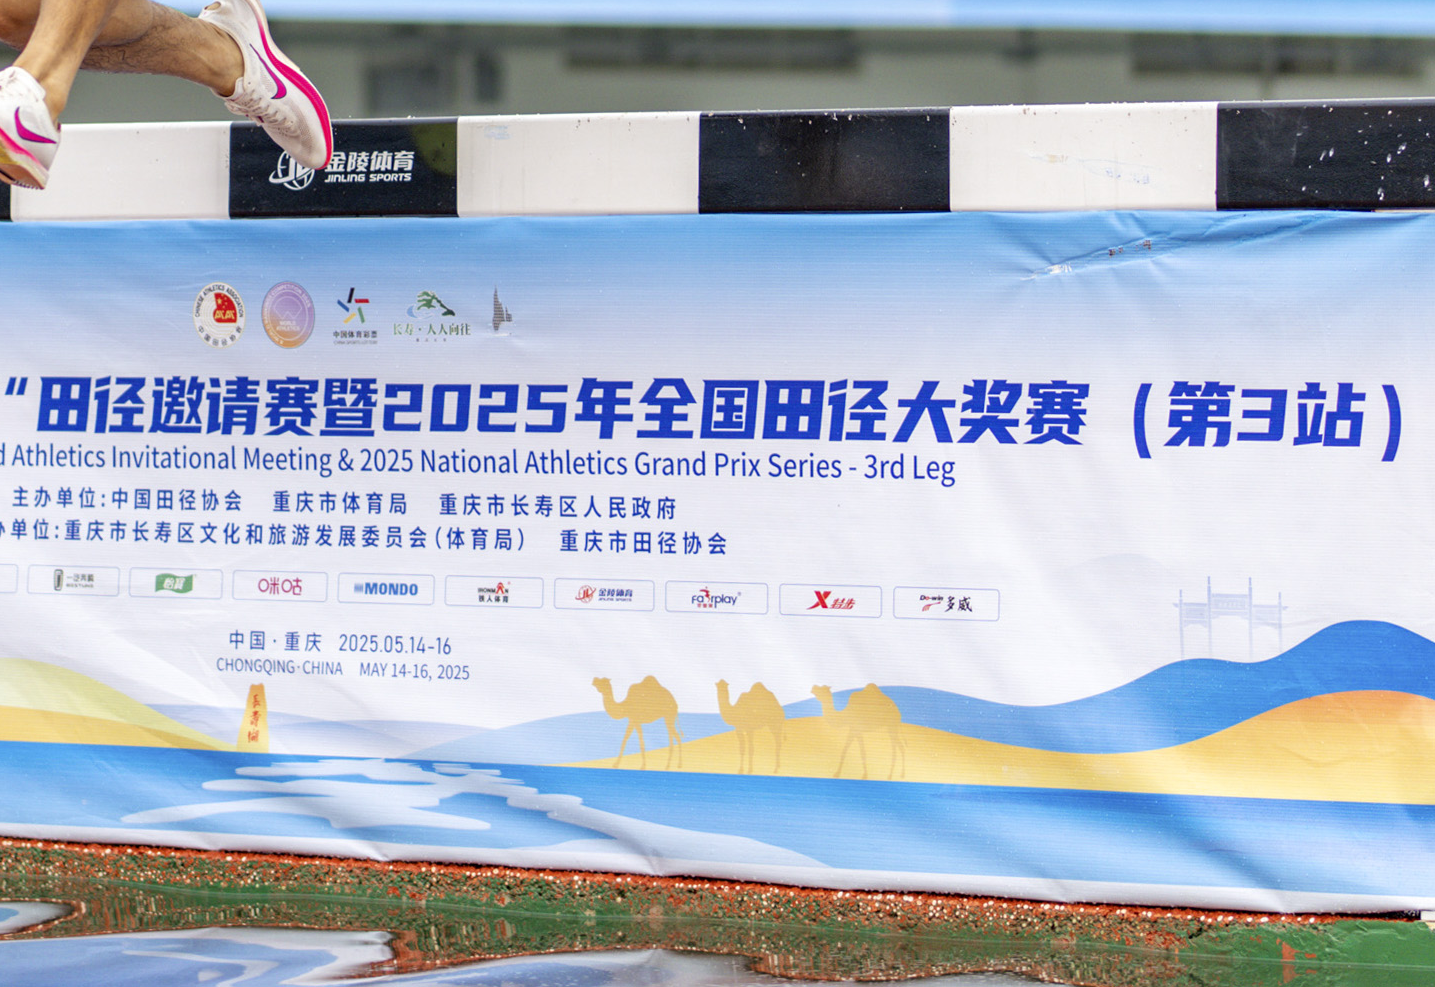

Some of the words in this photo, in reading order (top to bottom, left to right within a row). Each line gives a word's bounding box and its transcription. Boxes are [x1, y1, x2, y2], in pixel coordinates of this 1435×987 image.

[324, 150, 415, 173] 金陵体育
[324, 173, 366, 183] JINLING
[369, 172, 412, 182] SPORTS
[12, 443, 106, 468] Athletics
[112, 444, 236, 469] Invitational
[243, 446, 333, 478] Meeting
[337, 448, 354, 472] &
[360, 448, 414, 473] 2025
[421, 448, 519, 475] National
[524, 449, 628, 476] Athletics
[634, 451, 706, 477] Grand
[715, 451, 761, 478] Prix
[768, 453, 842, 479] Series
[864, 453, 905, 480] 3rd
[913, 454, 956, 488] Leg
[12, 486, 242, 512] 主办单位:中国田径协会
[272, 490, 408, 515] 重庆市体育局
[438, 492, 677, 520] 重庆市长寿区人民政府
[559, 528, 728, 556] 重庆市田径协会
[257, 576, 303, 596] 咪咕
[364, 582, 419, 597] MONDO
[944, 595, 973, 613] 多威
[338, 633, 452, 655] 2025.05.14-16
[359, 662, 388, 678] MAY
[392, 663, 432, 681] 14-16,
[437, 664, 470, 681] 2025
